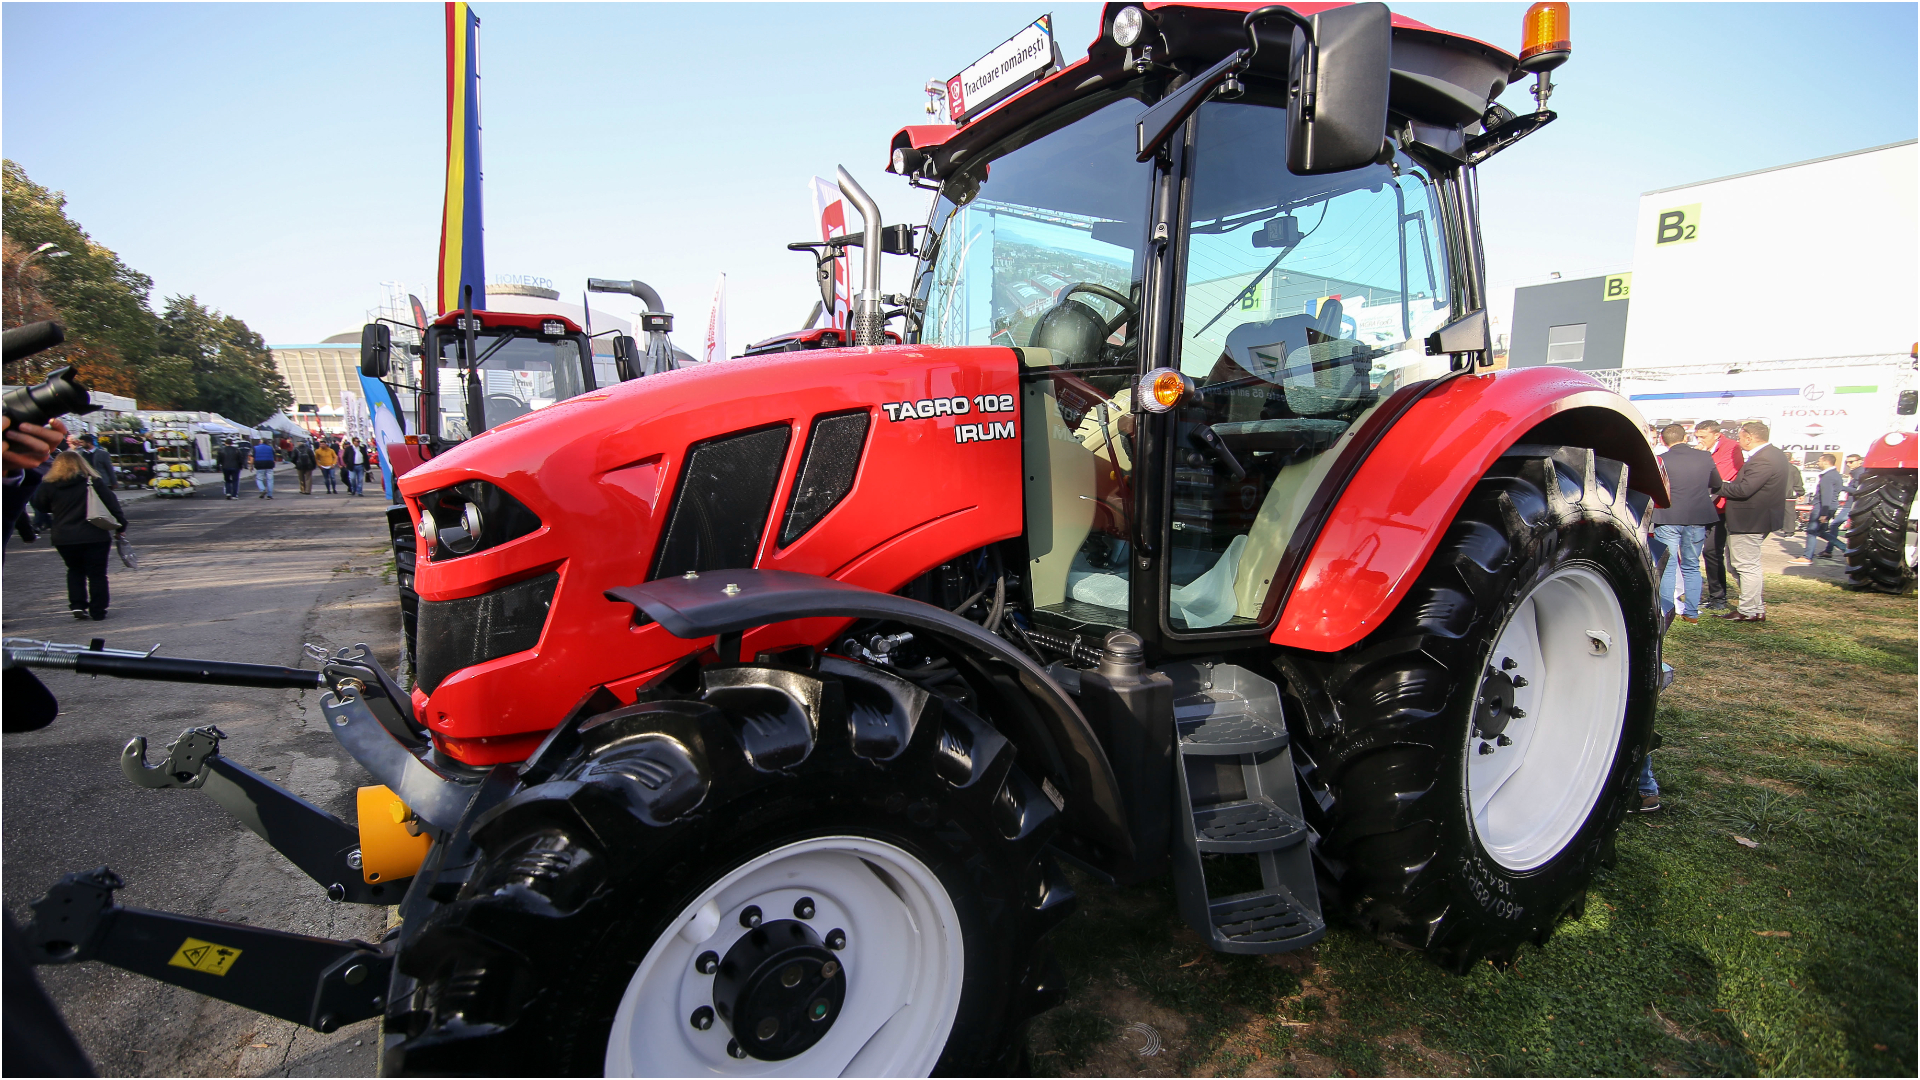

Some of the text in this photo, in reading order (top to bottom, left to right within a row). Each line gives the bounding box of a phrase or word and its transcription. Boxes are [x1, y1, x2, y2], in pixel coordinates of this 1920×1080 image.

[964, 33, 1044, 97] Tractoare românești
[1656, 210, 1697, 244] B2
[1607, 278, 1630, 297] B3
[883, 393, 1014, 422] TAGRO 102
[1781, 409, 1848, 417] HONDA
[954, 421, 1016, 443] IRUM
